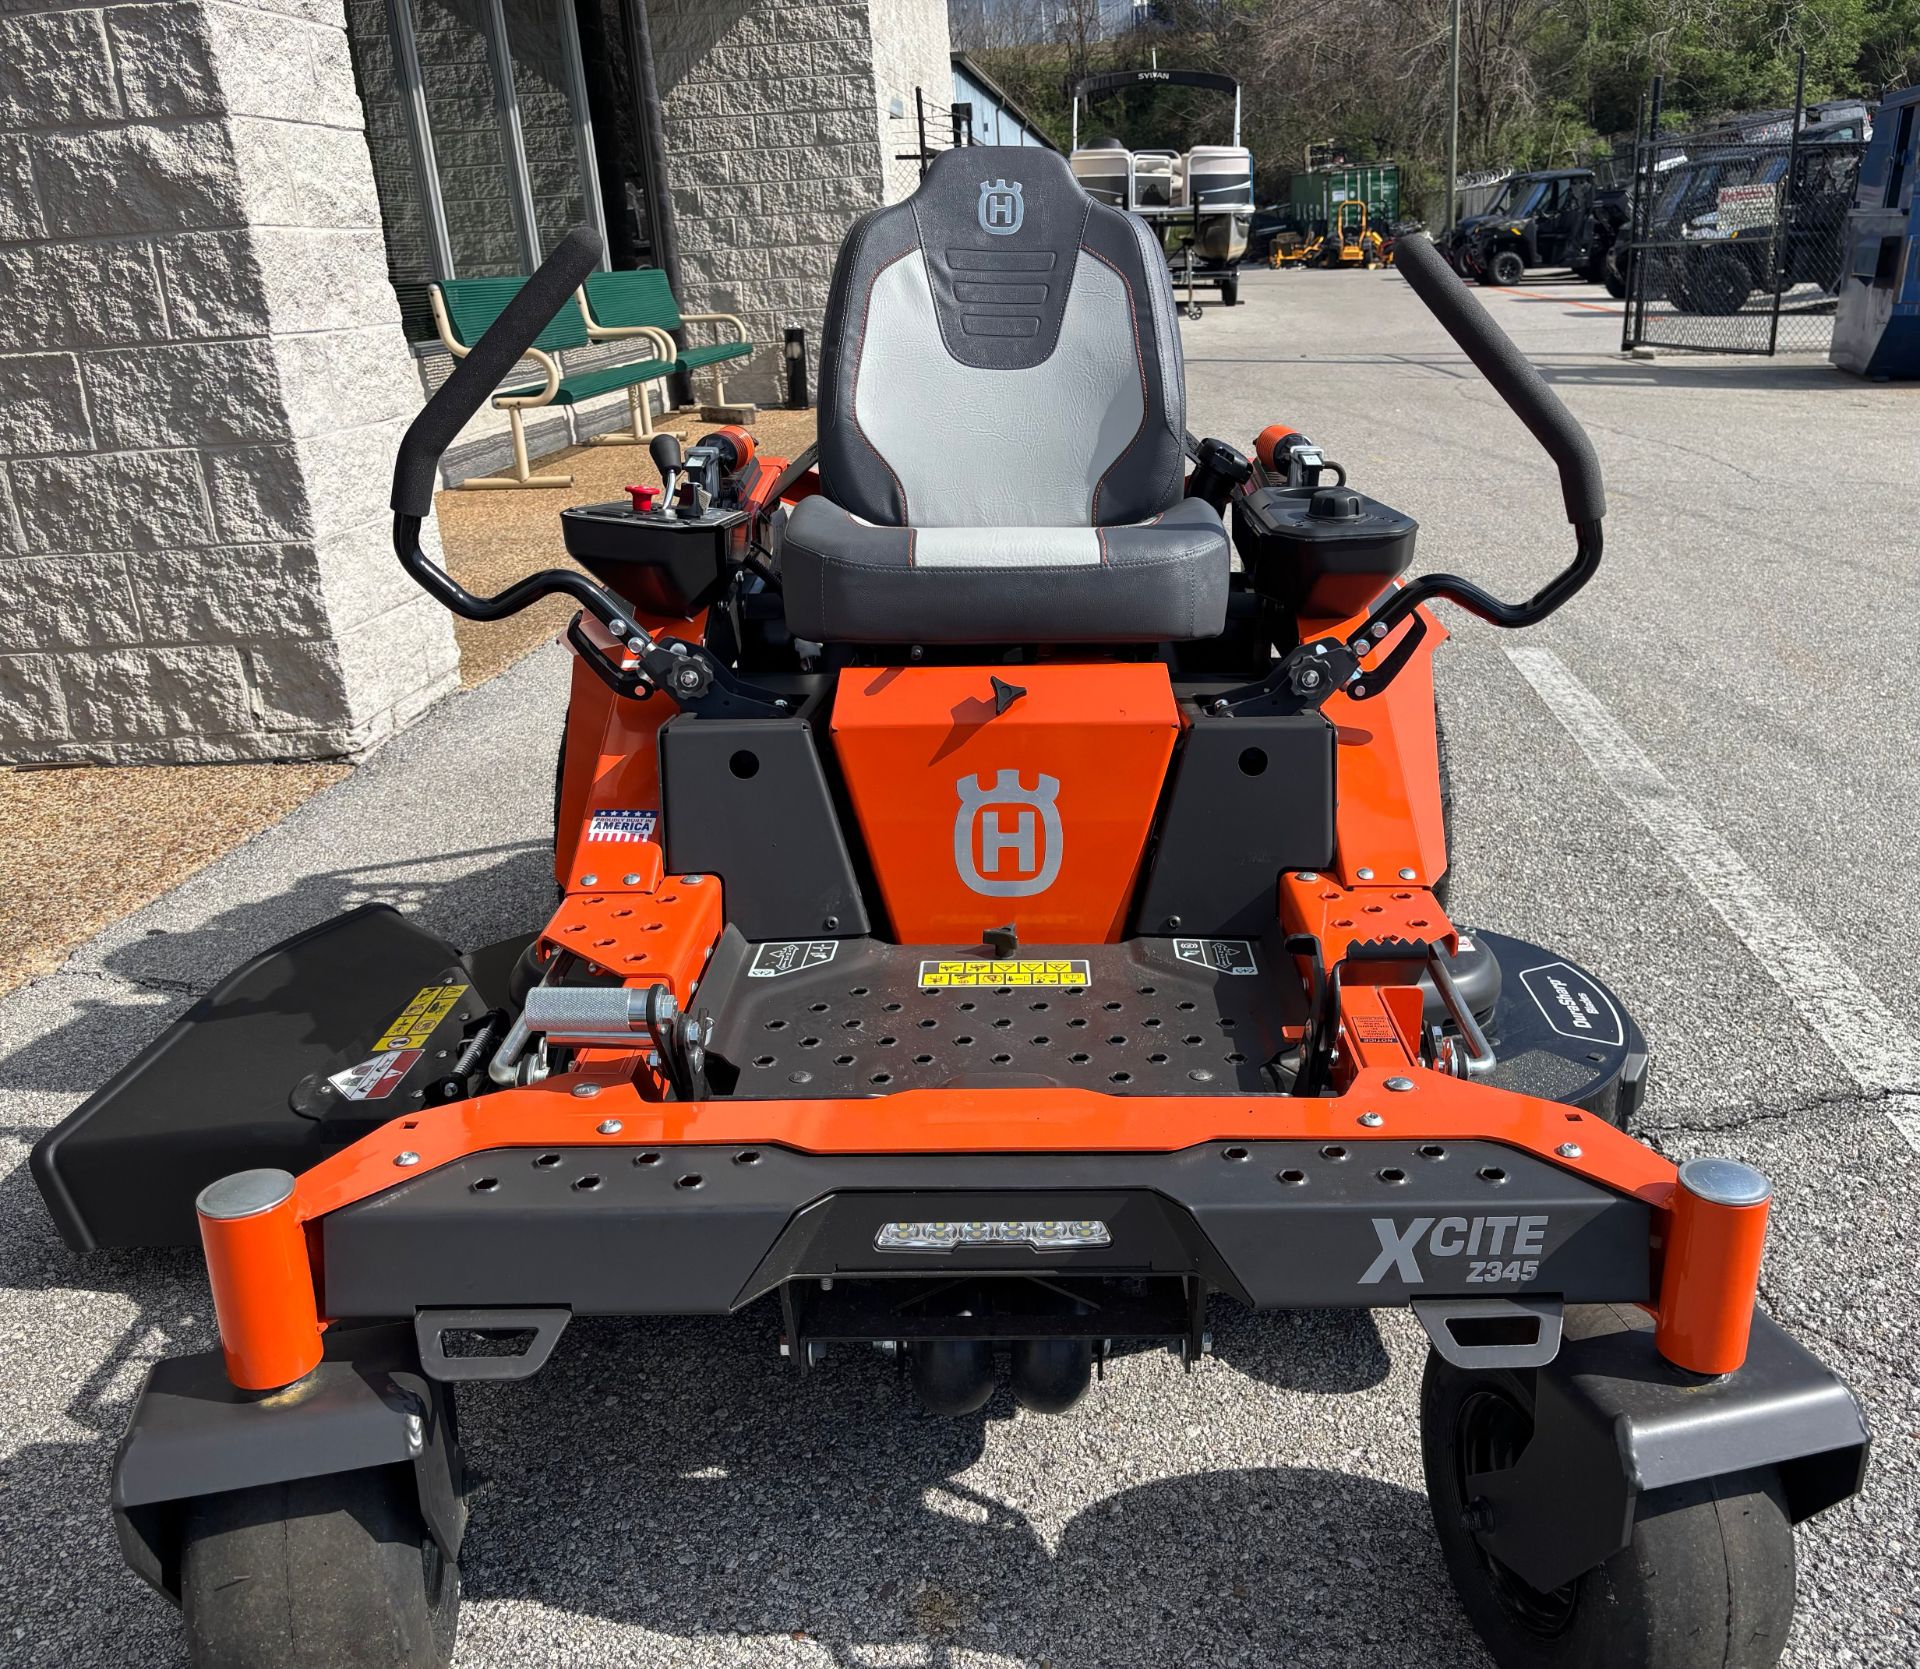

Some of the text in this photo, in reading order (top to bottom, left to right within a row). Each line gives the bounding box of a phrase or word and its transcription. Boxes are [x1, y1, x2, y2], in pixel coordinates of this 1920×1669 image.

[1137, 72, 1170, 80] SYLVAN
[593, 821, 650, 831] AMERICA
[1549, 978, 1593, 1029] DuraSharp
[1357, 1215, 1549, 1284] XCITE
[1465, 1260, 1540, 1283] Z345
